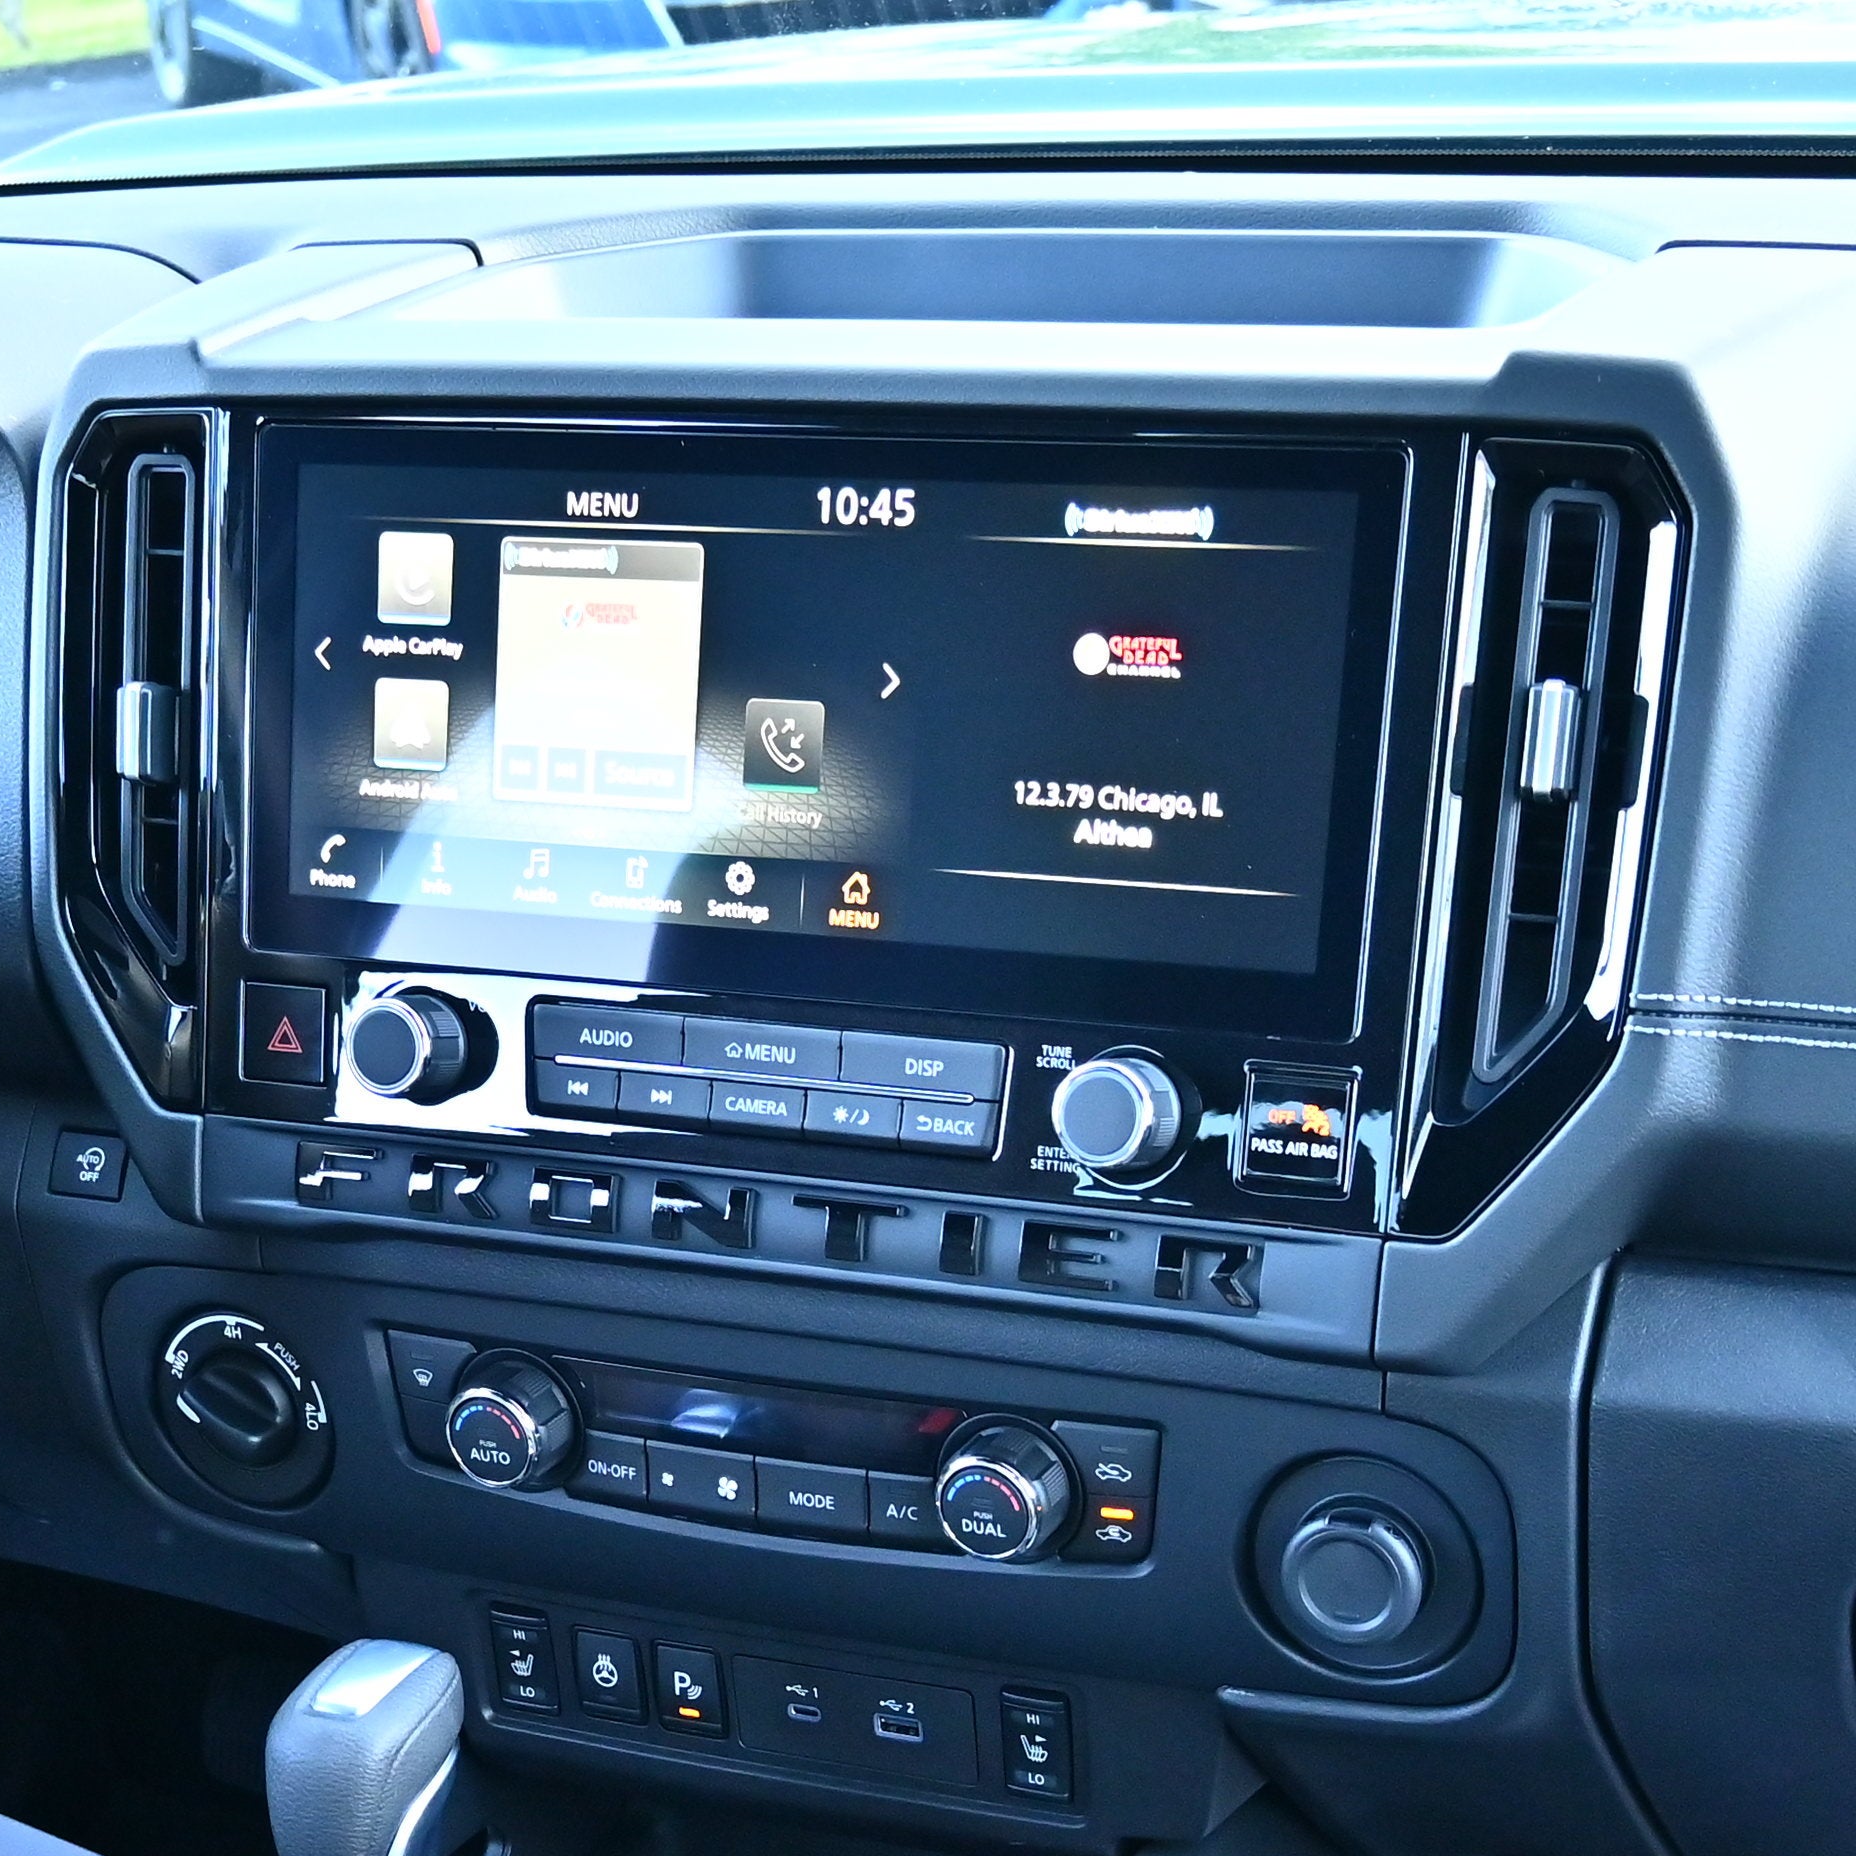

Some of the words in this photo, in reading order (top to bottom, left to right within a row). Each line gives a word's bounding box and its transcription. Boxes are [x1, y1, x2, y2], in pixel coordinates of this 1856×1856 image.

[567, 491, 639, 518] MENU
[817, 486, 916, 526] 10:45
[362, 634, 406, 657] Apple
[408, 636, 464, 660] CarPlay
[1109, 635, 1182, 660] GRATEFUL
[1123, 650, 1169, 666] DEAD
[358, 778, 420, 800] Android
[1014, 780, 1095, 809] 12.3.79
[1097, 785, 1197, 820] Chicago,
[1201, 791, 1224, 818] IL
[767, 805, 823, 829] History
[1073, 818, 1153, 848] Althea
[309, 867, 356, 889] Phone
[421, 879, 453, 896] Info
[513, 886, 558, 904] Audio
[707, 899, 770, 924] Settings
[828, 908, 880, 930] MENU
[579, 1027, 634, 1049] AUDIO
[744, 1043, 796, 1065] MENU
[1041, 1044, 1073, 1059] TUNE
[904, 1057, 945, 1078] DISP
[725, 1096, 788, 1117] CAMERA
[1268, 1108, 1296, 1124] OFF
[932, 1118, 976, 1137] BACK
[76, 1153, 100, 1165] AUTO
[1251, 1137, 1286, 1155] PASS
[1287, 1141, 1308, 1157] AIR
[1310, 1143, 1338, 1160] BAG
[79, 1171, 100, 1183] OFF
[1030, 1159, 1082, 1174] SETTING
[296, 1140, 1261, 1317] FRONTIER
[223, 1325, 242, 1340] 4H
[171, 1349, 189, 1380] 2WD
[273, 1342, 301, 1371] PUSH
[304, 1402, 319, 1431] 4LO
[470, 1447, 511, 1465] AUTO
[788, 1490, 837, 1511] MODE
[886, 1503, 919, 1521] A/C
[961, 1517, 1008, 1539] DUAL
[513, 1629, 526, 1641] HI
[520, 1685, 535, 1698] LO
[906, 1702, 915, 1714] 2
[1025, 1713, 1040, 1726] HI
[1028, 1772, 1045, 1786] LO
